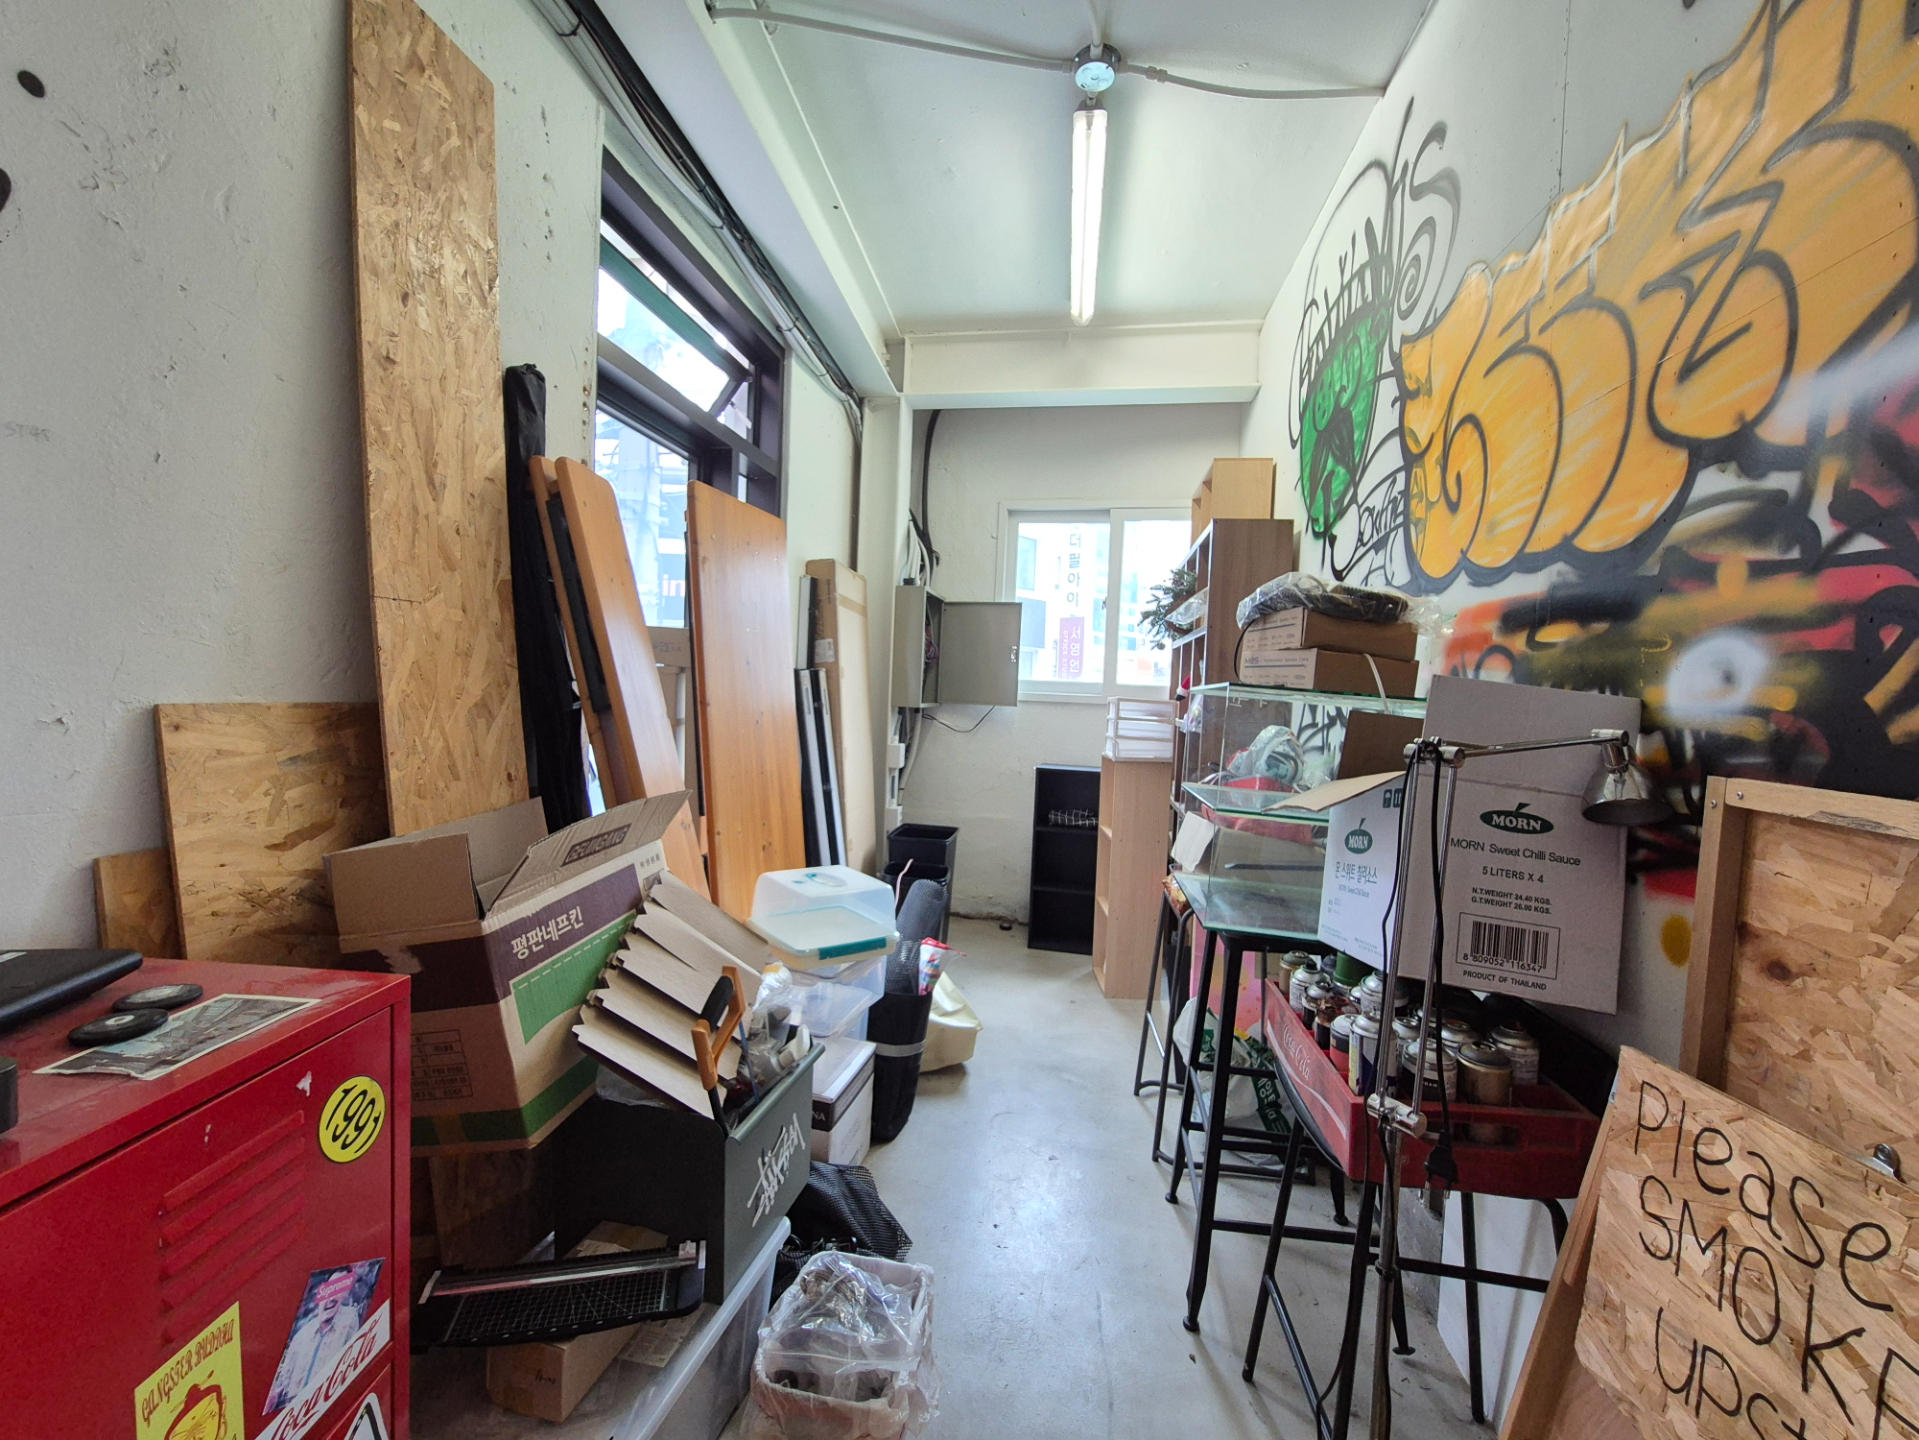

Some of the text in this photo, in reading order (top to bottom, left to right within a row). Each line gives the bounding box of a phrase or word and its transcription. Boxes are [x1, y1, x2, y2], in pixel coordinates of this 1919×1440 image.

[1491, 814, 1542, 832] MORN
[1348, 833, 1368, 851] MORN
[1450, 837, 1582, 866] MORN Sweet Chilli Sauce
[1482, 866, 1545, 883] 5 LITERS X 4
[1533, 906, 1552, 915] KGS.
[1534, 897, 1553, 906] KGS.
[510, 906, 584, 960] 평판네프킨
[1463, 953, 1543, 973] 8 809052 116347
[1463, 970, 1547, 990] PRODUCT OF THAILAND
[325, 1084, 381, 1153] 1991
[1634, 1080, 1893, 1313] Please
[316, 1276, 354, 1299] Supreme
[141, 1353, 194, 1428] GANGSTER
